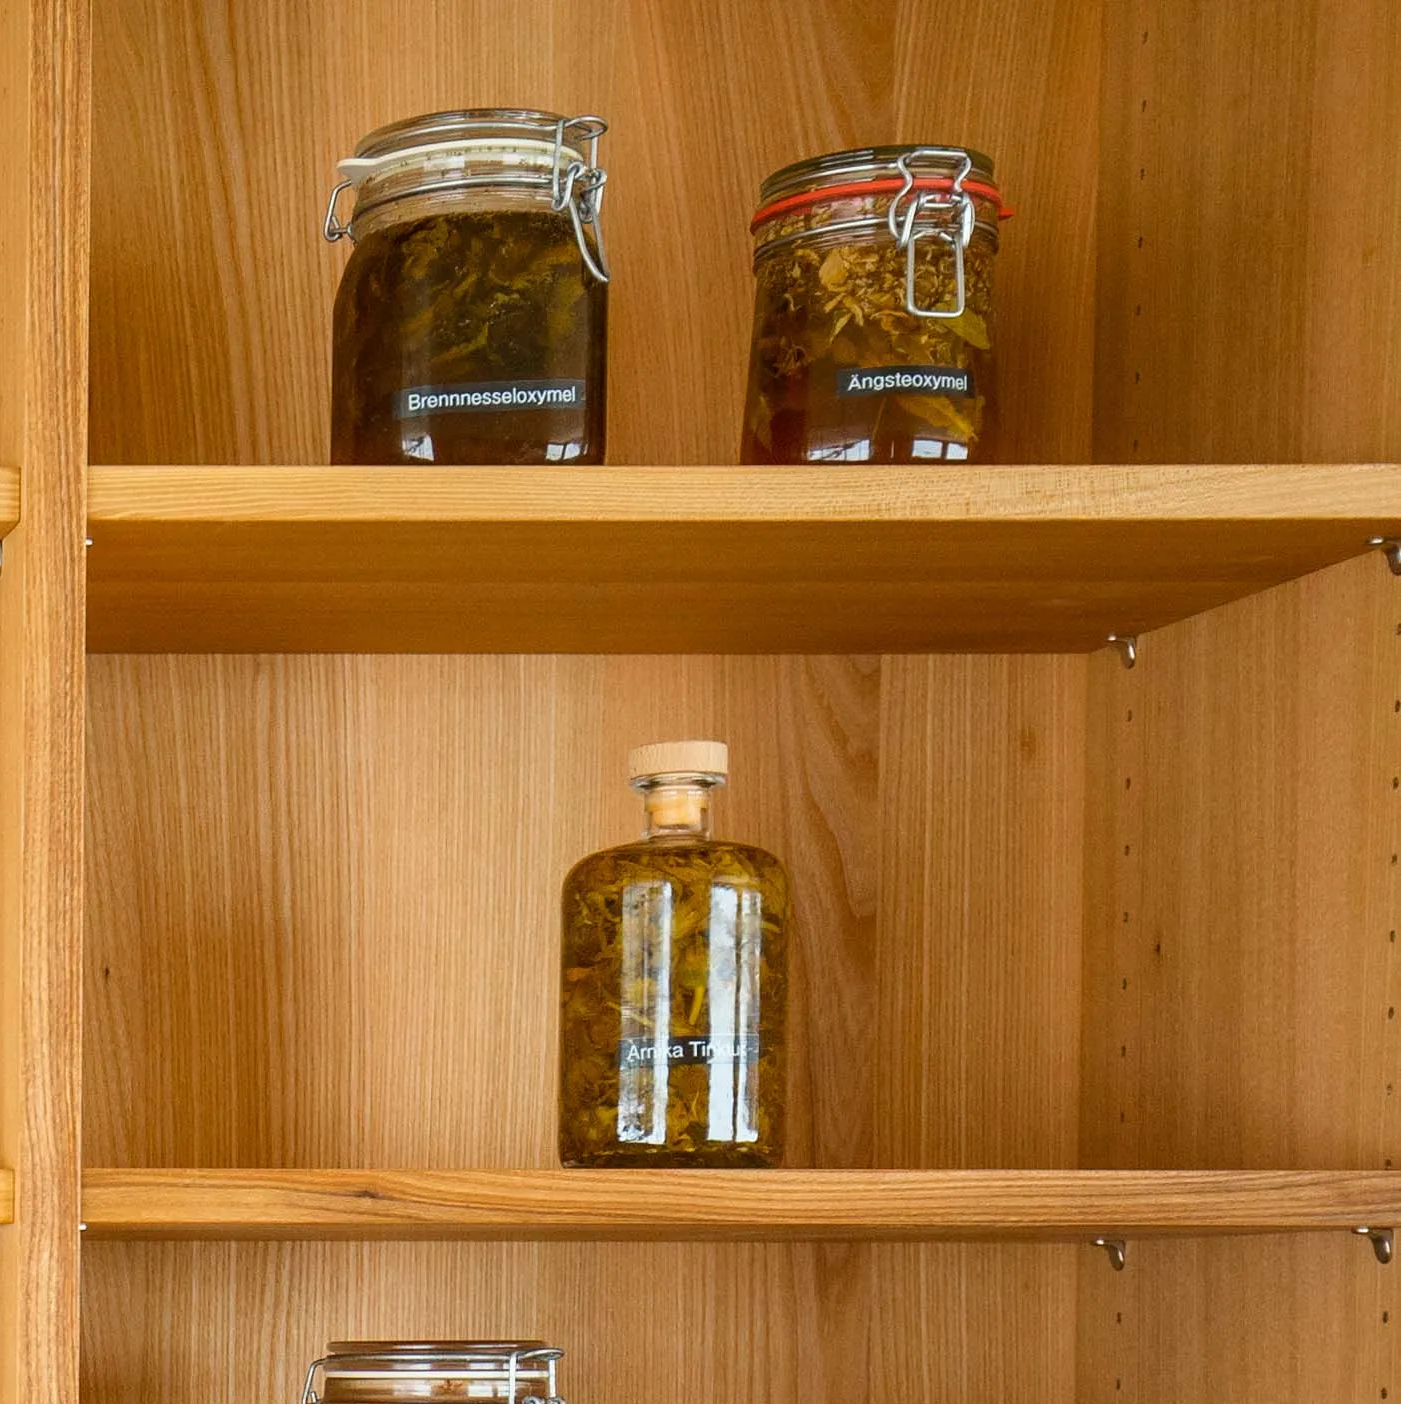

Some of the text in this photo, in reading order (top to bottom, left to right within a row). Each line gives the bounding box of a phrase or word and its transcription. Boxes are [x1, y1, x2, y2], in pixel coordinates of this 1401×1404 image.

[847, 371, 968, 392] Ängsteoxymel
[408, 386, 577, 412] Brennnesseloxymel
[627, 1043, 685, 1061] Arnka
